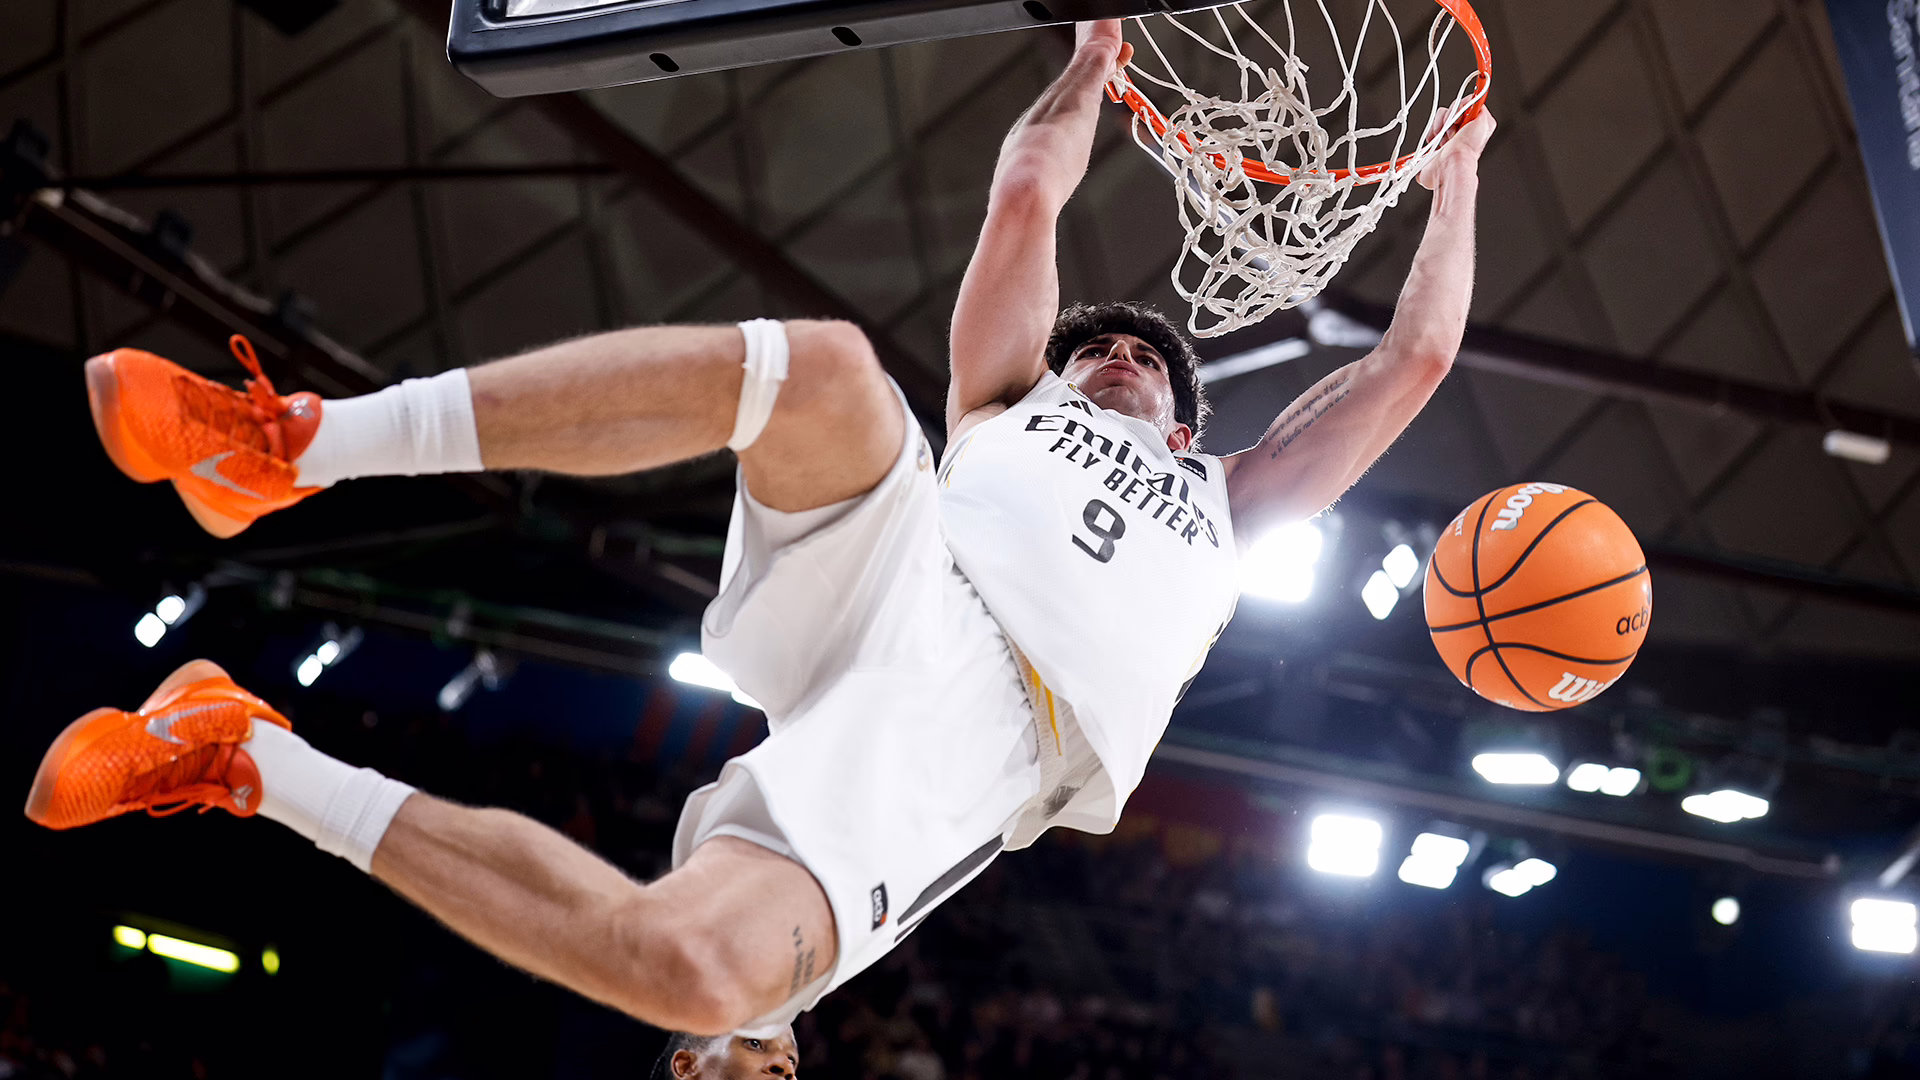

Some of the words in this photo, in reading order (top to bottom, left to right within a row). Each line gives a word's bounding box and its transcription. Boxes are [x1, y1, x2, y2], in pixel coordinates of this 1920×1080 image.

[1048, 436, 1101, 470] FLY
[1102, 467, 1199, 546] BETTER
[1071, 498, 1127, 564] 9
[1616, 606, 1649, 636] acb
